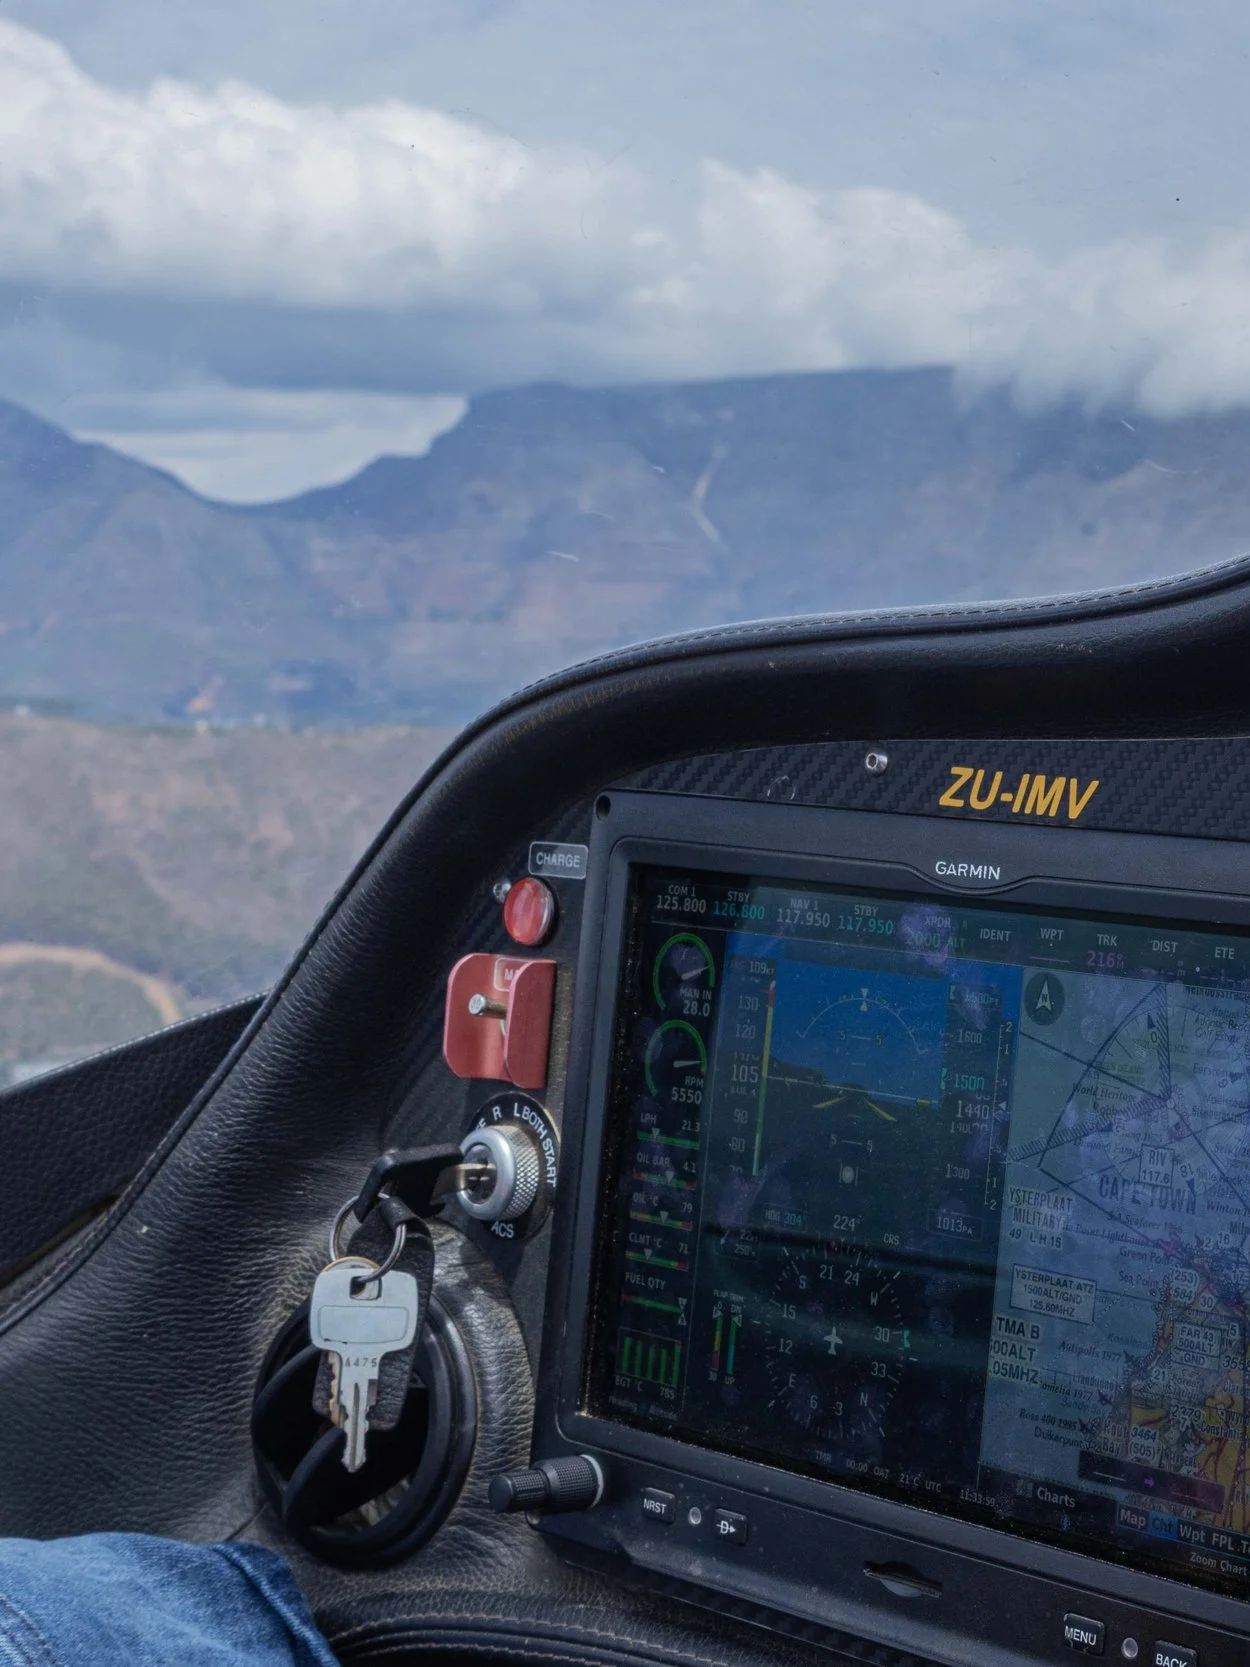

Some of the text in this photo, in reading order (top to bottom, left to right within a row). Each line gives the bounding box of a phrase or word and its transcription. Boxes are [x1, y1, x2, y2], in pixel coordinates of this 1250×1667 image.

[939, 766, 1099, 820] ZU-IMV
[536, 853, 581, 867] CHARGE
[935, 861, 1001, 880] GARMIN
[668, 884, 688, 896] COM
[728, 891, 749, 902] STBY
[657, 895, 707, 914] 125.800
[713, 902, 765, 920] 126.800
[854, 904, 878, 916] STBY
[777, 909, 830, 928] 117.950
[838, 916, 893, 934] 117.950
[980, 928, 1011, 942] IDENT
[1041, 928, 1064, 941] WPT
[1098, 934, 1118, 947] TRK
[1152, 940, 1178, 953] DIST
[1214, 947, 1235, 960] ETE
[683, 1001, 710, 1017] 28.0
[671, 1088, 702, 1103] 5550
[493, 1107, 501, 1120] R
[514, 1102, 520, 1118] L
[522, 1105, 547, 1140] BOTH
[542, 1139, 556, 1187] START
[490, 1221, 514, 1238] ACS
[1170, 1269, 1197, 1284] (253)
[996, 1317, 1027, 1337] TMA
[643, 1498, 667, 1514] NRST
[1037, 1488, 1076, 1509] Charts
[1120, 1509, 1146, 1528] Map
[1152, 1517, 1174, 1535] Cht
[1180, 1524, 1206, 1544] Wpt
[1212, 1533, 1235, 1551] FPL
[1190, 1552, 1217, 1568] Zoom
[1220, 1560, 1248, 1577] Chart
[1064, 1626, 1097, 1646] MENU
